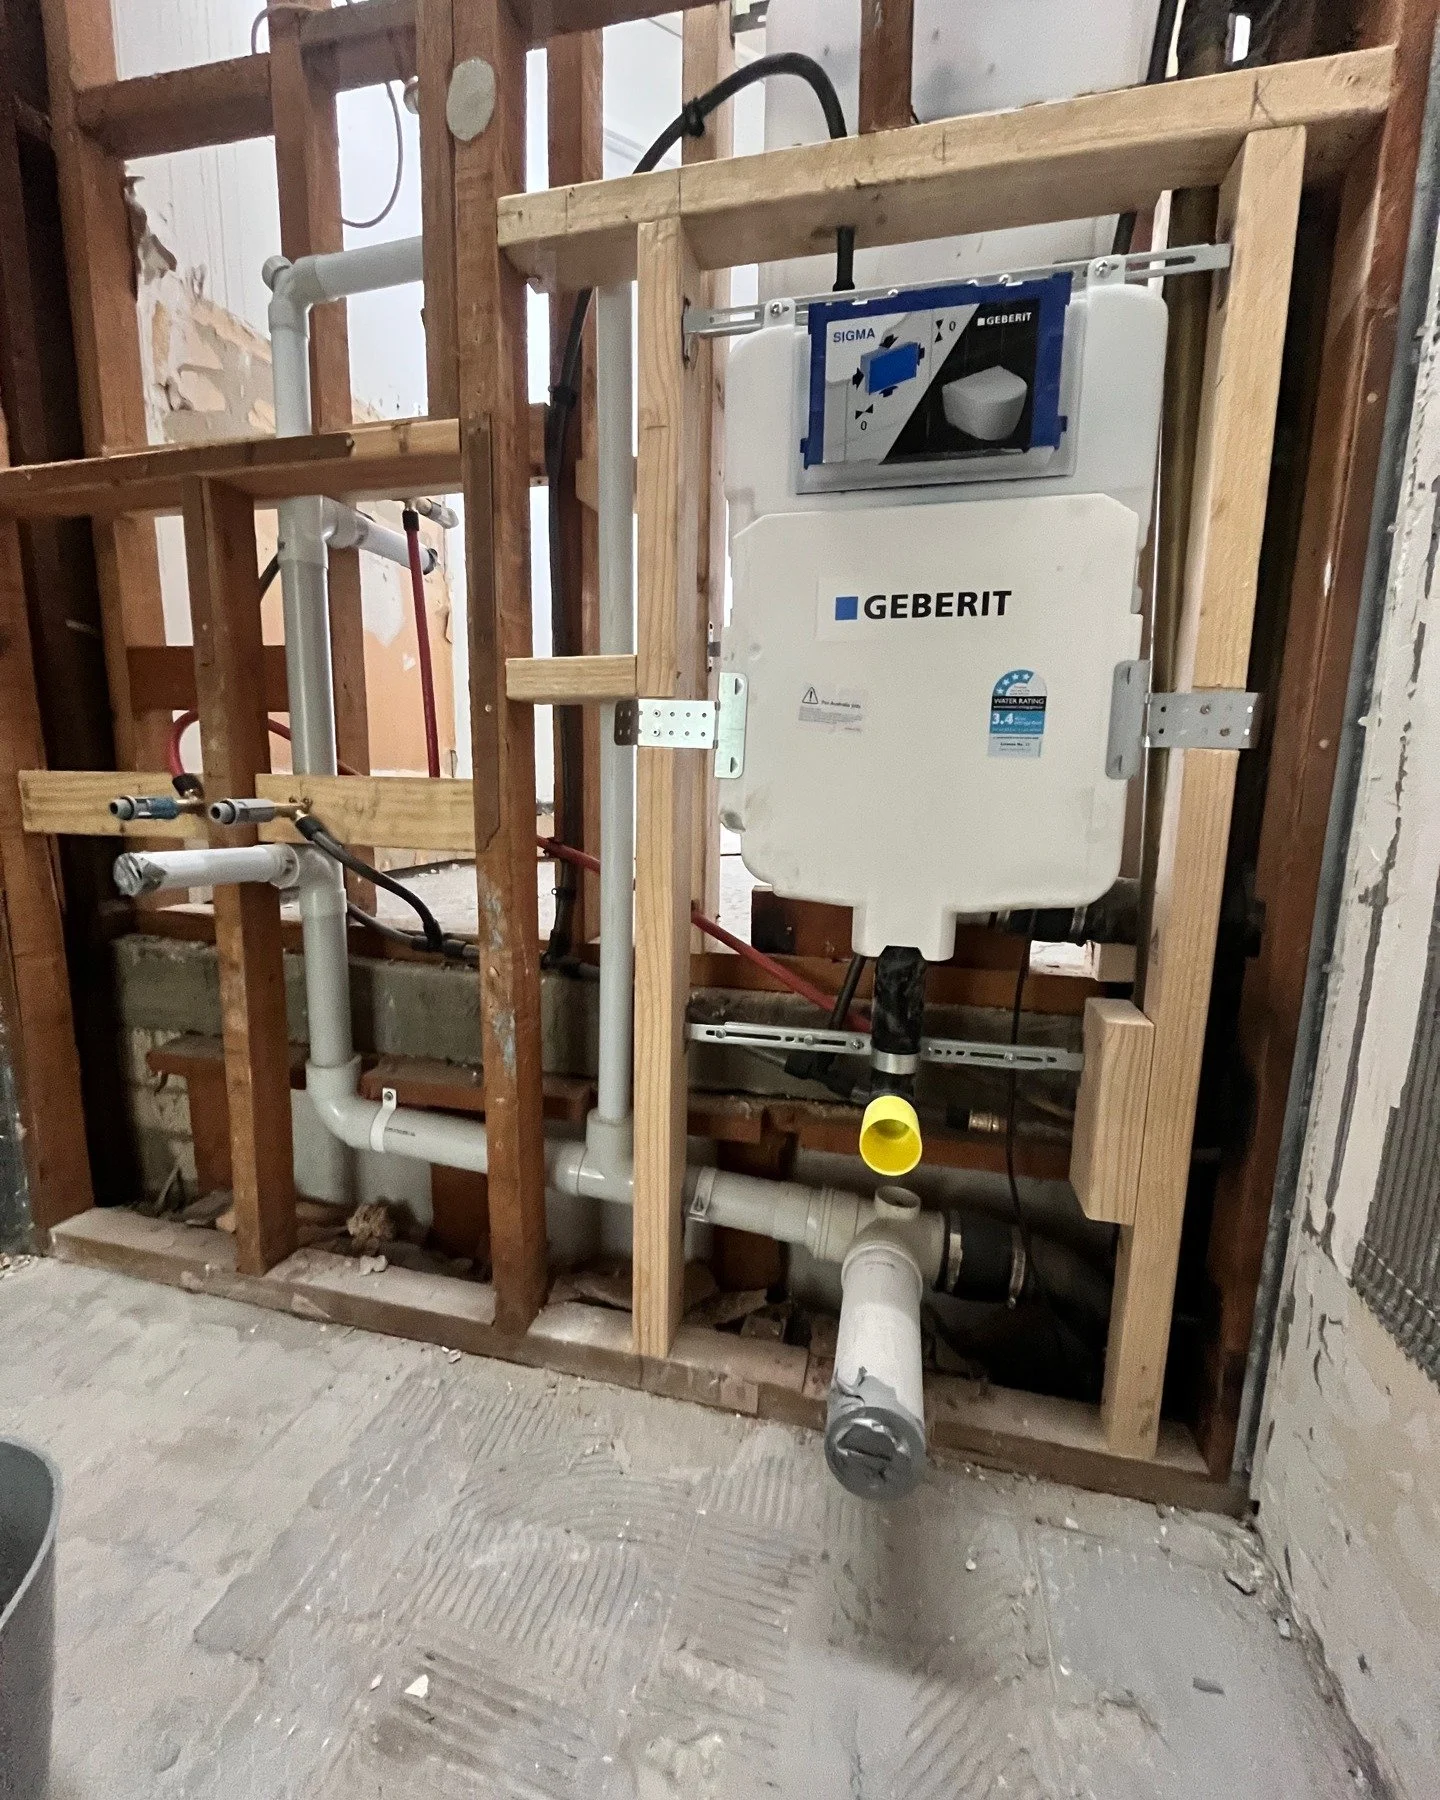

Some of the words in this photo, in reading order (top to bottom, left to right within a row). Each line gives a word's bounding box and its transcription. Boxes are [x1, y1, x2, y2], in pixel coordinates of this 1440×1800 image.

[986, 312, 1032, 326] GEBERIT
[833, 328, 875, 343] SIGMA
[864, 591, 1012, 620] GEBERIT
[994, 697, 1017, 705] WATER
[1019, 697, 1044, 705] RATING
[992, 712, 1014, 725] 3.4
